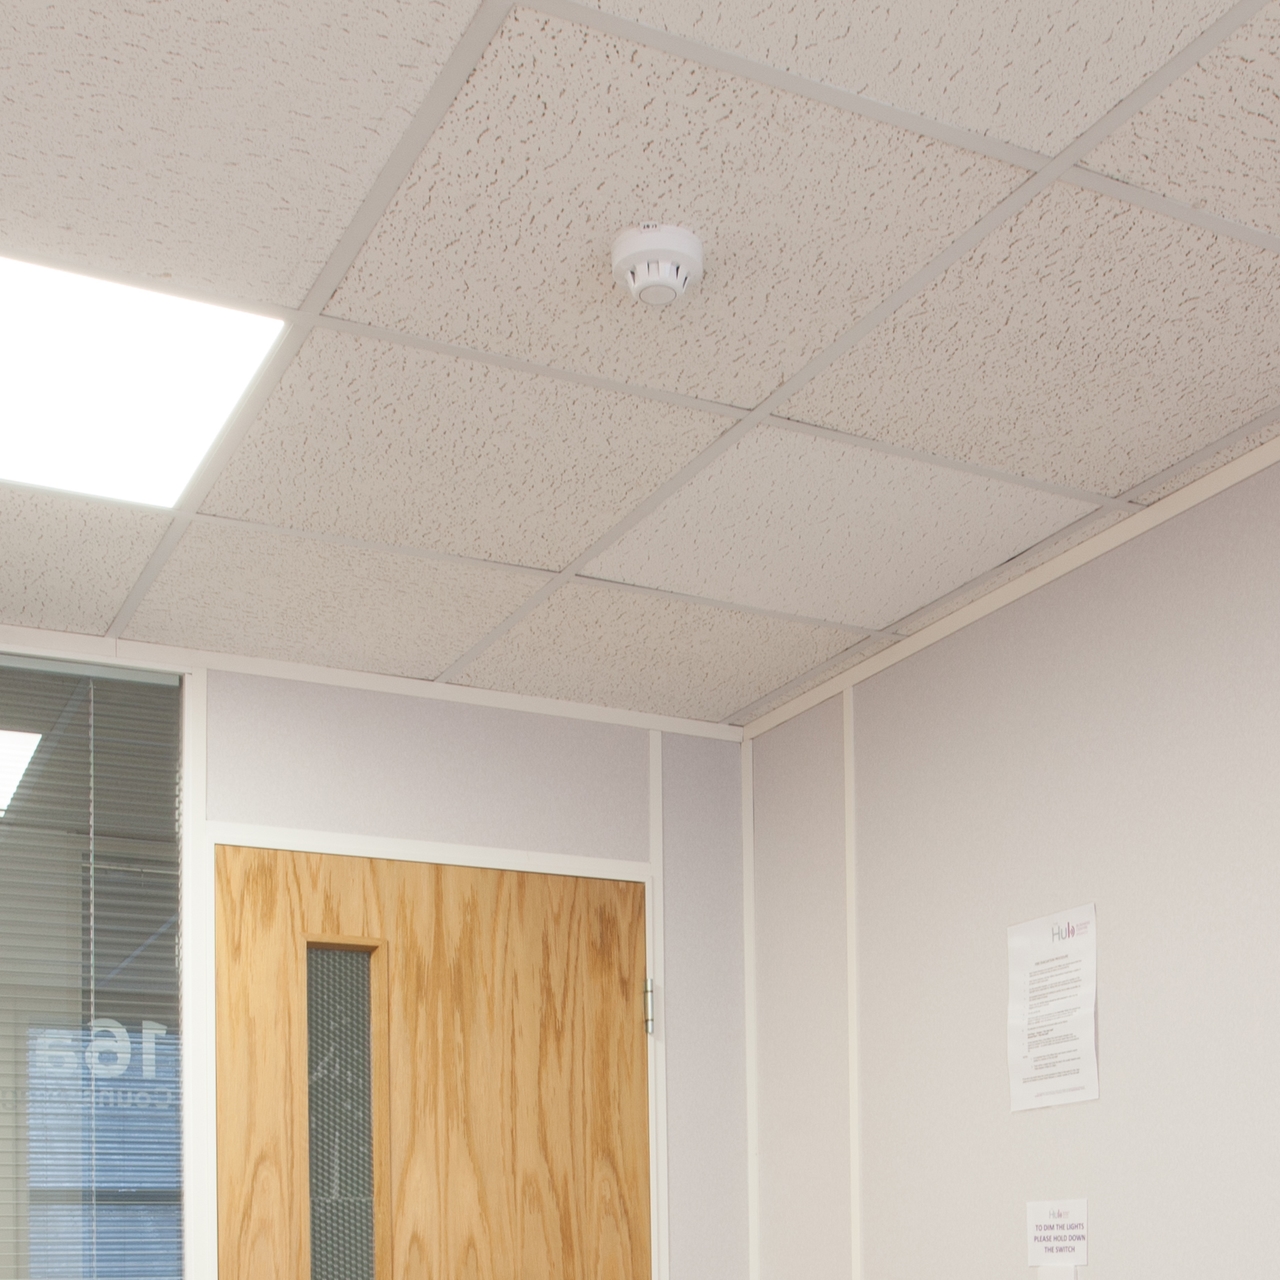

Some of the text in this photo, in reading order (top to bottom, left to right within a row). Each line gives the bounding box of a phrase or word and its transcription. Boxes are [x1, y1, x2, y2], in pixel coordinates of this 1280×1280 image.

[1035, 1223, 1084, 1232] TO DIM THE LIGHTS
[1034, 1234, 1086, 1243] PLEASE HOLD DOWN
